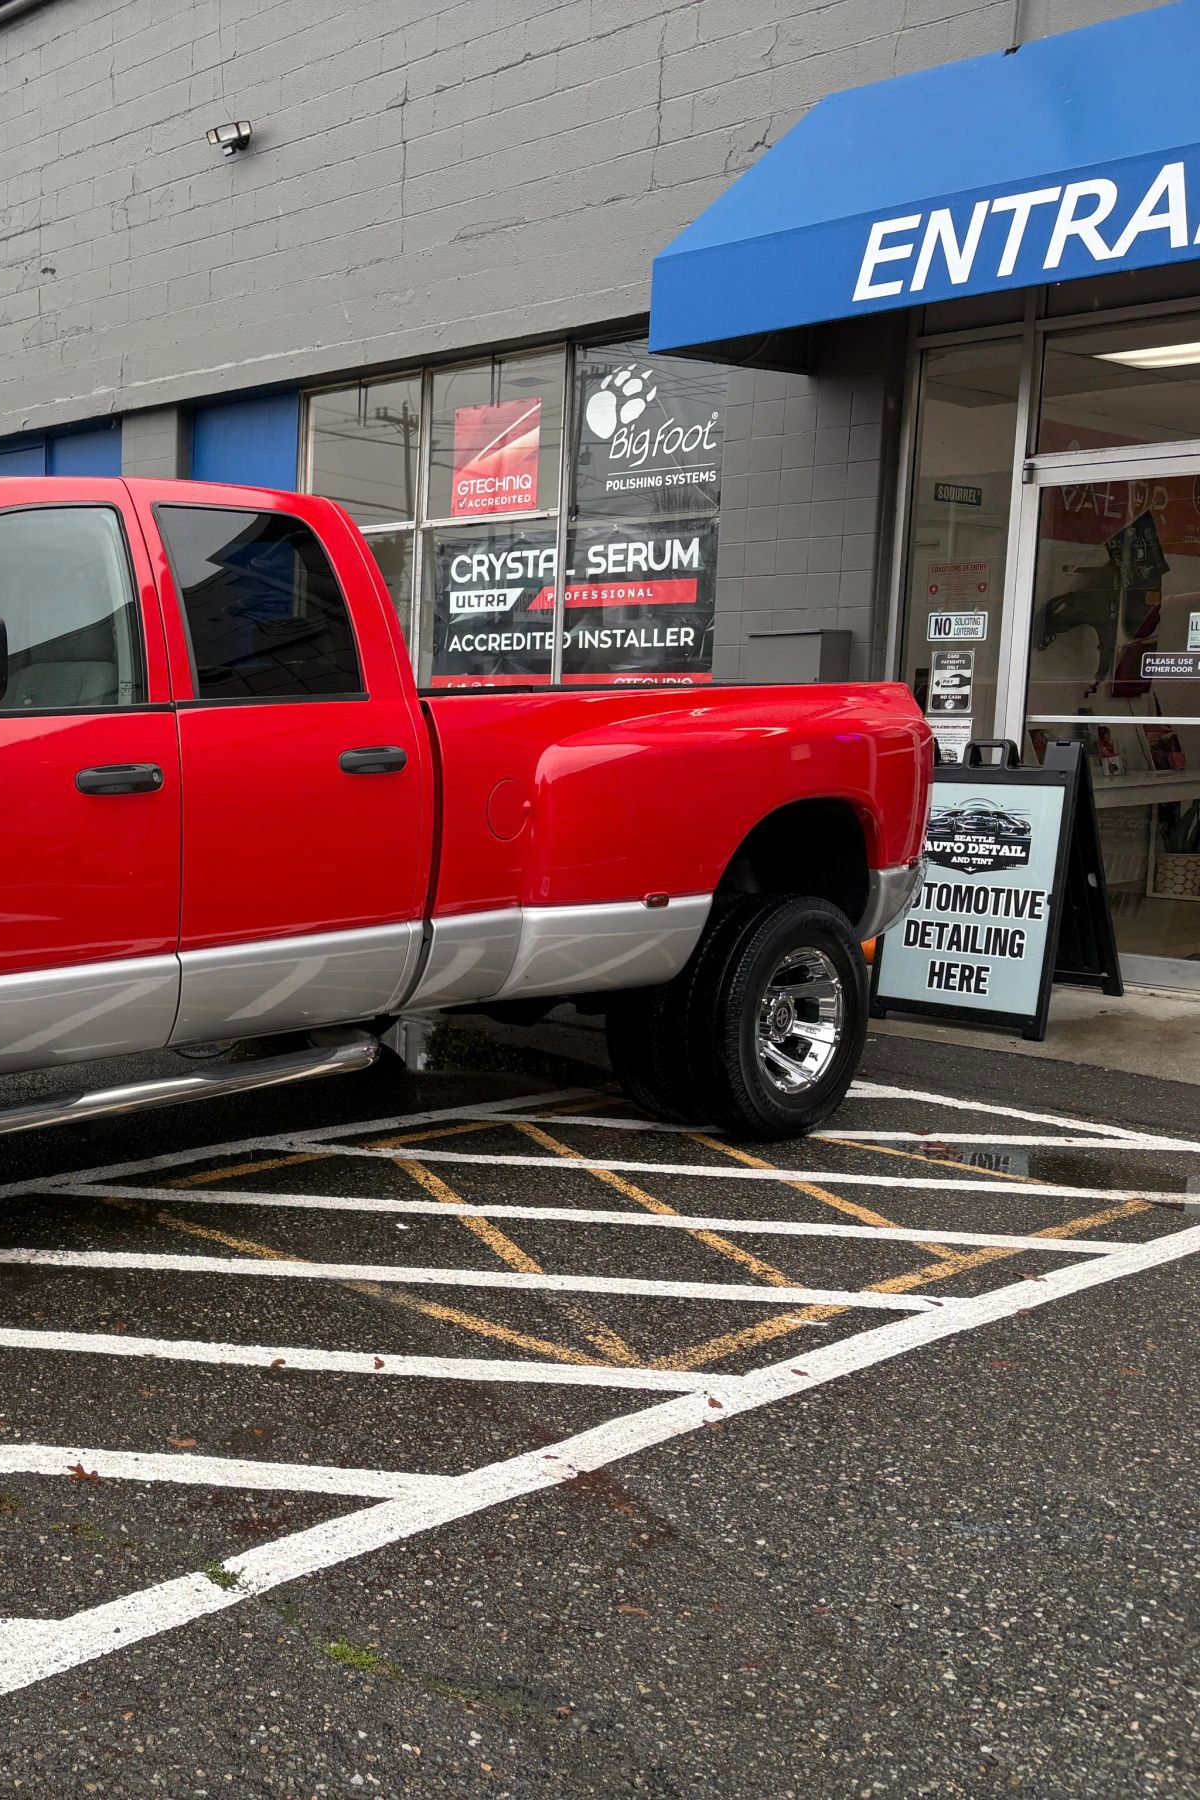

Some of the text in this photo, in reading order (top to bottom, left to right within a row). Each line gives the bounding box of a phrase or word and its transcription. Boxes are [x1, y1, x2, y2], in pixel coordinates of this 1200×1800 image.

[851, 161, 1200, 302] ENTRA
[457, 473, 533, 496] GTECHNIQ
[606, 470, 717, 491] POLISHING SYSTEMS
[467, 494, 531, 508] ACCREDITED
[938, 485, 977, 503] SQUIRREL
[587, 537, 700, 575] SERUM
[455, 592, 507, 609] ULTRA
[547, 586, 655, 602] POFESSIONAL
[934, 617, 980, 636] NO SOLICITING
[953, 627, 979, 636] LOITERING
[578, 627, 696, 648] INSTALLER
[954, 834, 995, 843] SEATTLE
[951, 856, 994, 866] AND TINT
[967, 843, 1026, 858] DETAIL
[913, 882, 1046, 920] TOMOTIVE
[904, 919, 1025, 959] DETAILING
[927, 960, 991, 995] HERE
